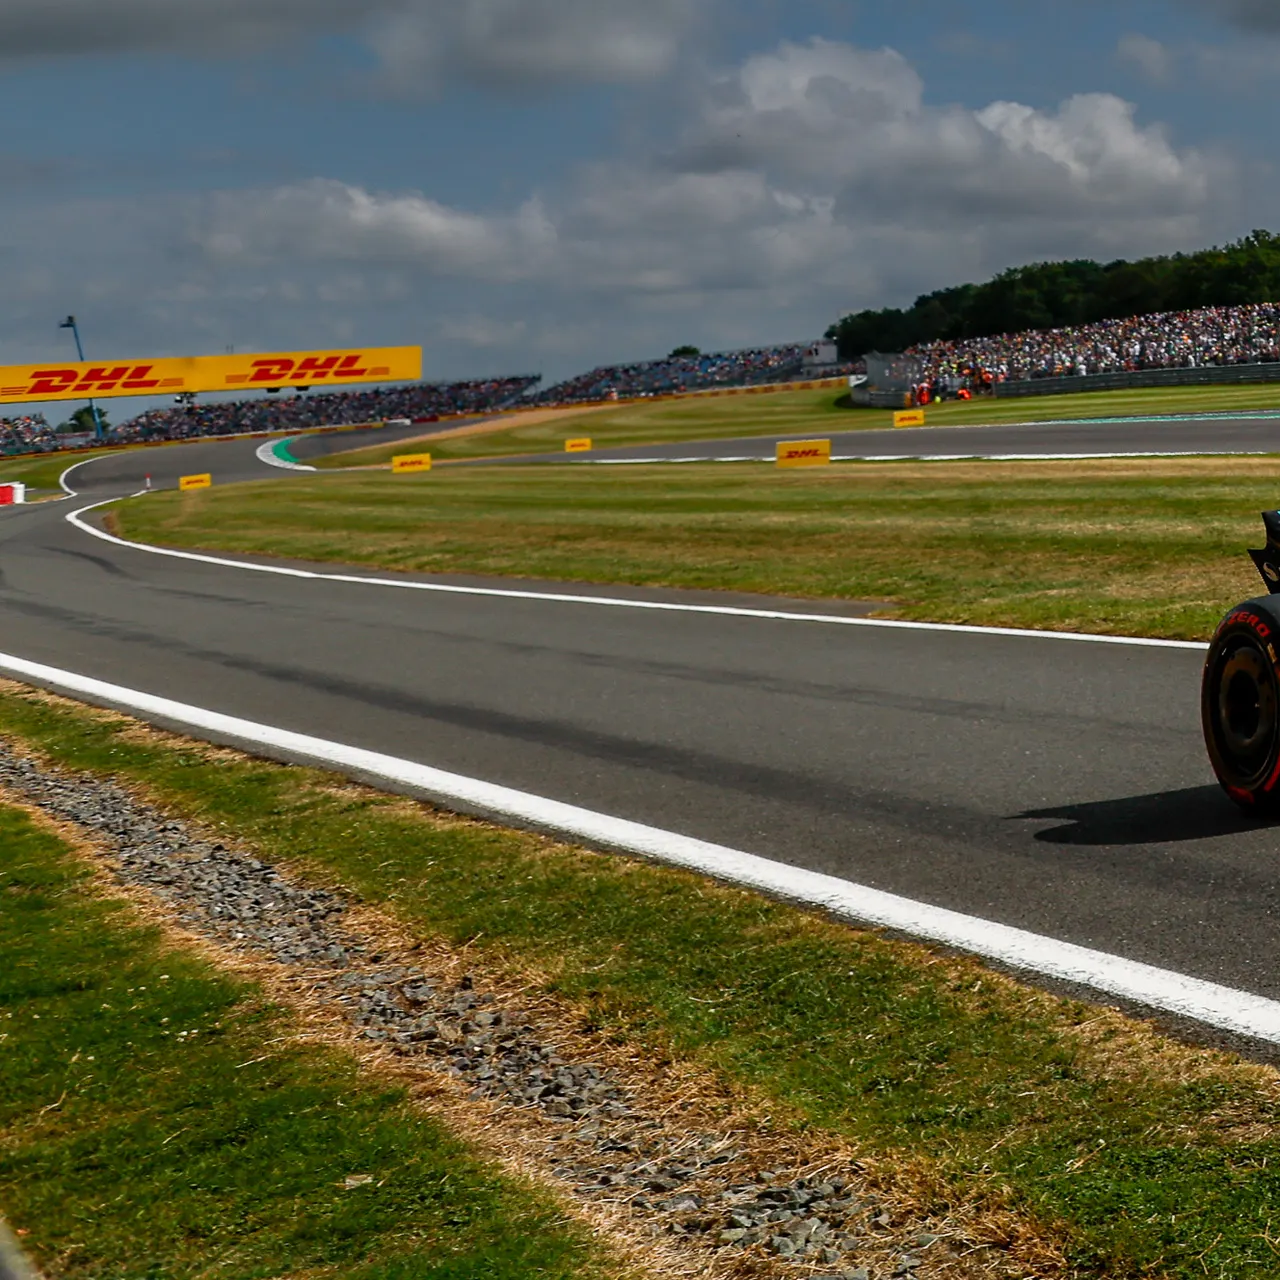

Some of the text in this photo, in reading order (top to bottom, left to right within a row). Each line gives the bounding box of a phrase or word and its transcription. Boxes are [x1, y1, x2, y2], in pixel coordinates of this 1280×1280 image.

[27, 365, 161, 394] DHL
[249, 355, 368, 381] DHL
[786, 449, 820, 458] DHL
